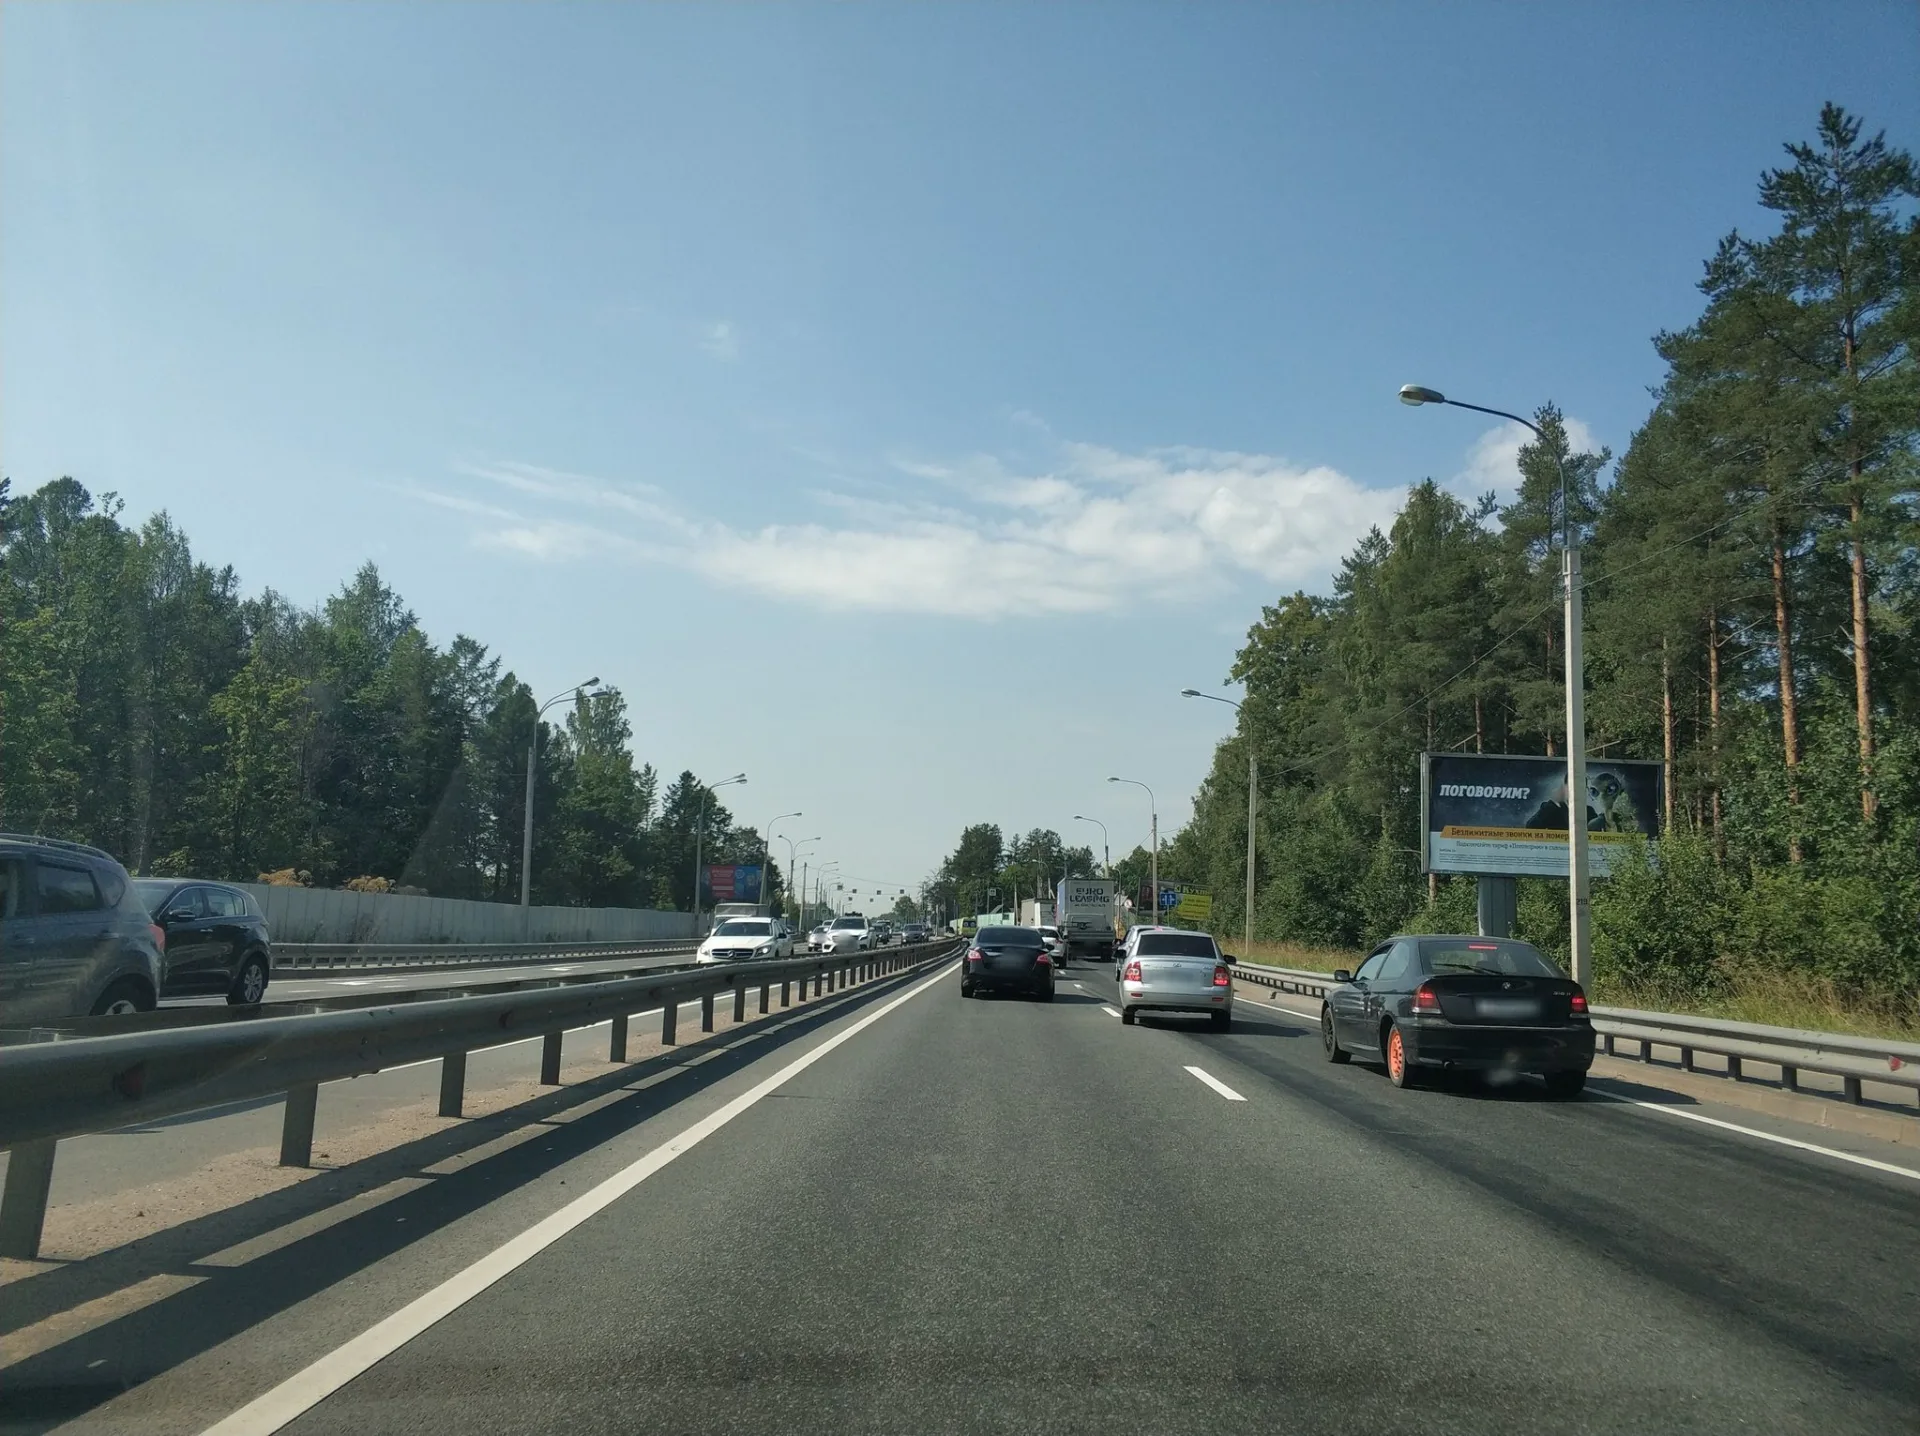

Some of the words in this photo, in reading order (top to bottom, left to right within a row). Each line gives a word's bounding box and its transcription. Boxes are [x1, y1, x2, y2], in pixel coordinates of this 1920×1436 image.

[1439, 784, 1530, 800] ПОГОВОРИМ?
[1451, 827, 1504, 838] Безлимитные
[1505, 831, 1532, 839] звонки
[1076, 887, 1104, 895] EURO
[1070, 895, 1110, 903] LEASING
